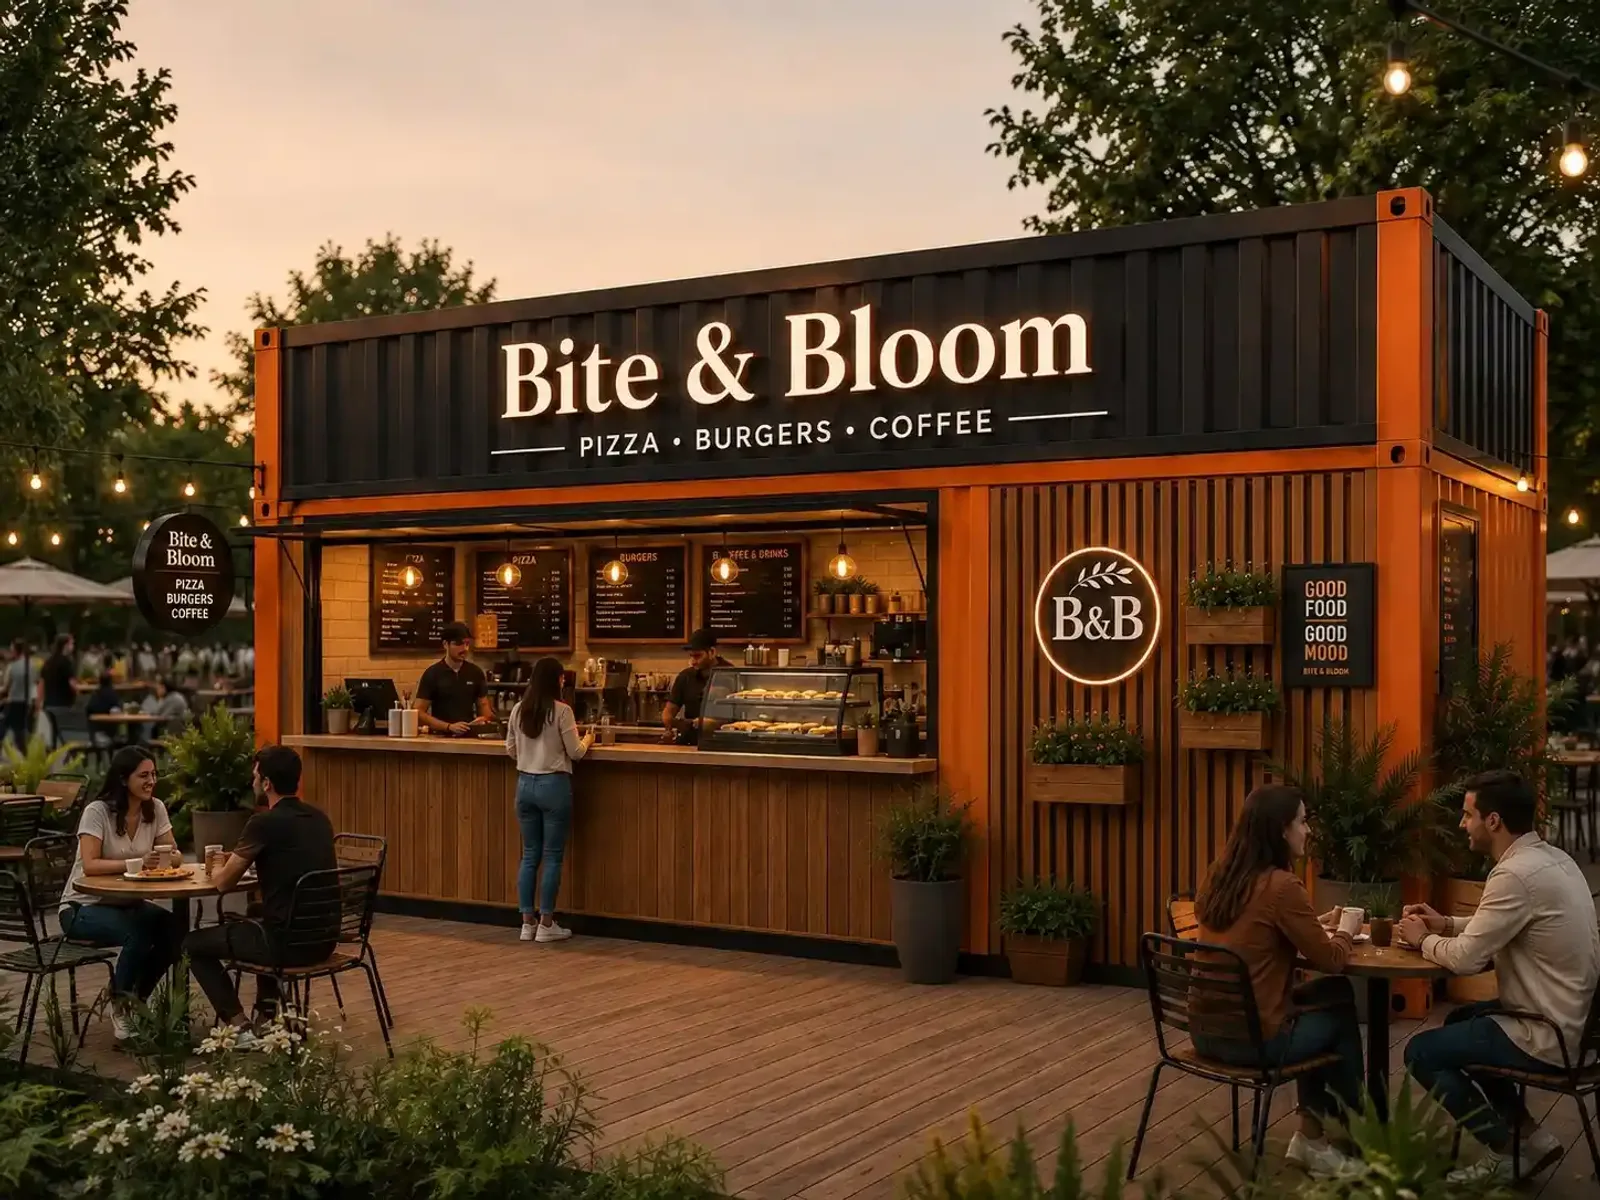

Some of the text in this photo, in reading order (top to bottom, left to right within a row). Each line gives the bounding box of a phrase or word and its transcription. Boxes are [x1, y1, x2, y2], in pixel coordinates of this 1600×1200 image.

[502, 303, 1092, 419] Bite & Bloom
[580, 408, 992, 458] PIZZA BURGERS COFFEE
[168, 531, 213, 549] Bite &
[166, 548, 215, 567] Bloom
[512, 555, 537, 565] PIZZA
[175, 578, 205, 591] PIZZA
[1305, 580, 1347, 598] GOOD
[166, 592, 214, 605] BURGERS
[171, 607, 209, 619] COFFEE
[1305, 599, 1347, 617] FOOD
[1052, 595, 1144, 641] B&B
[1305, 625, 1347, 643] GOOD
[1304, 644, 1348, 662] MOOD
